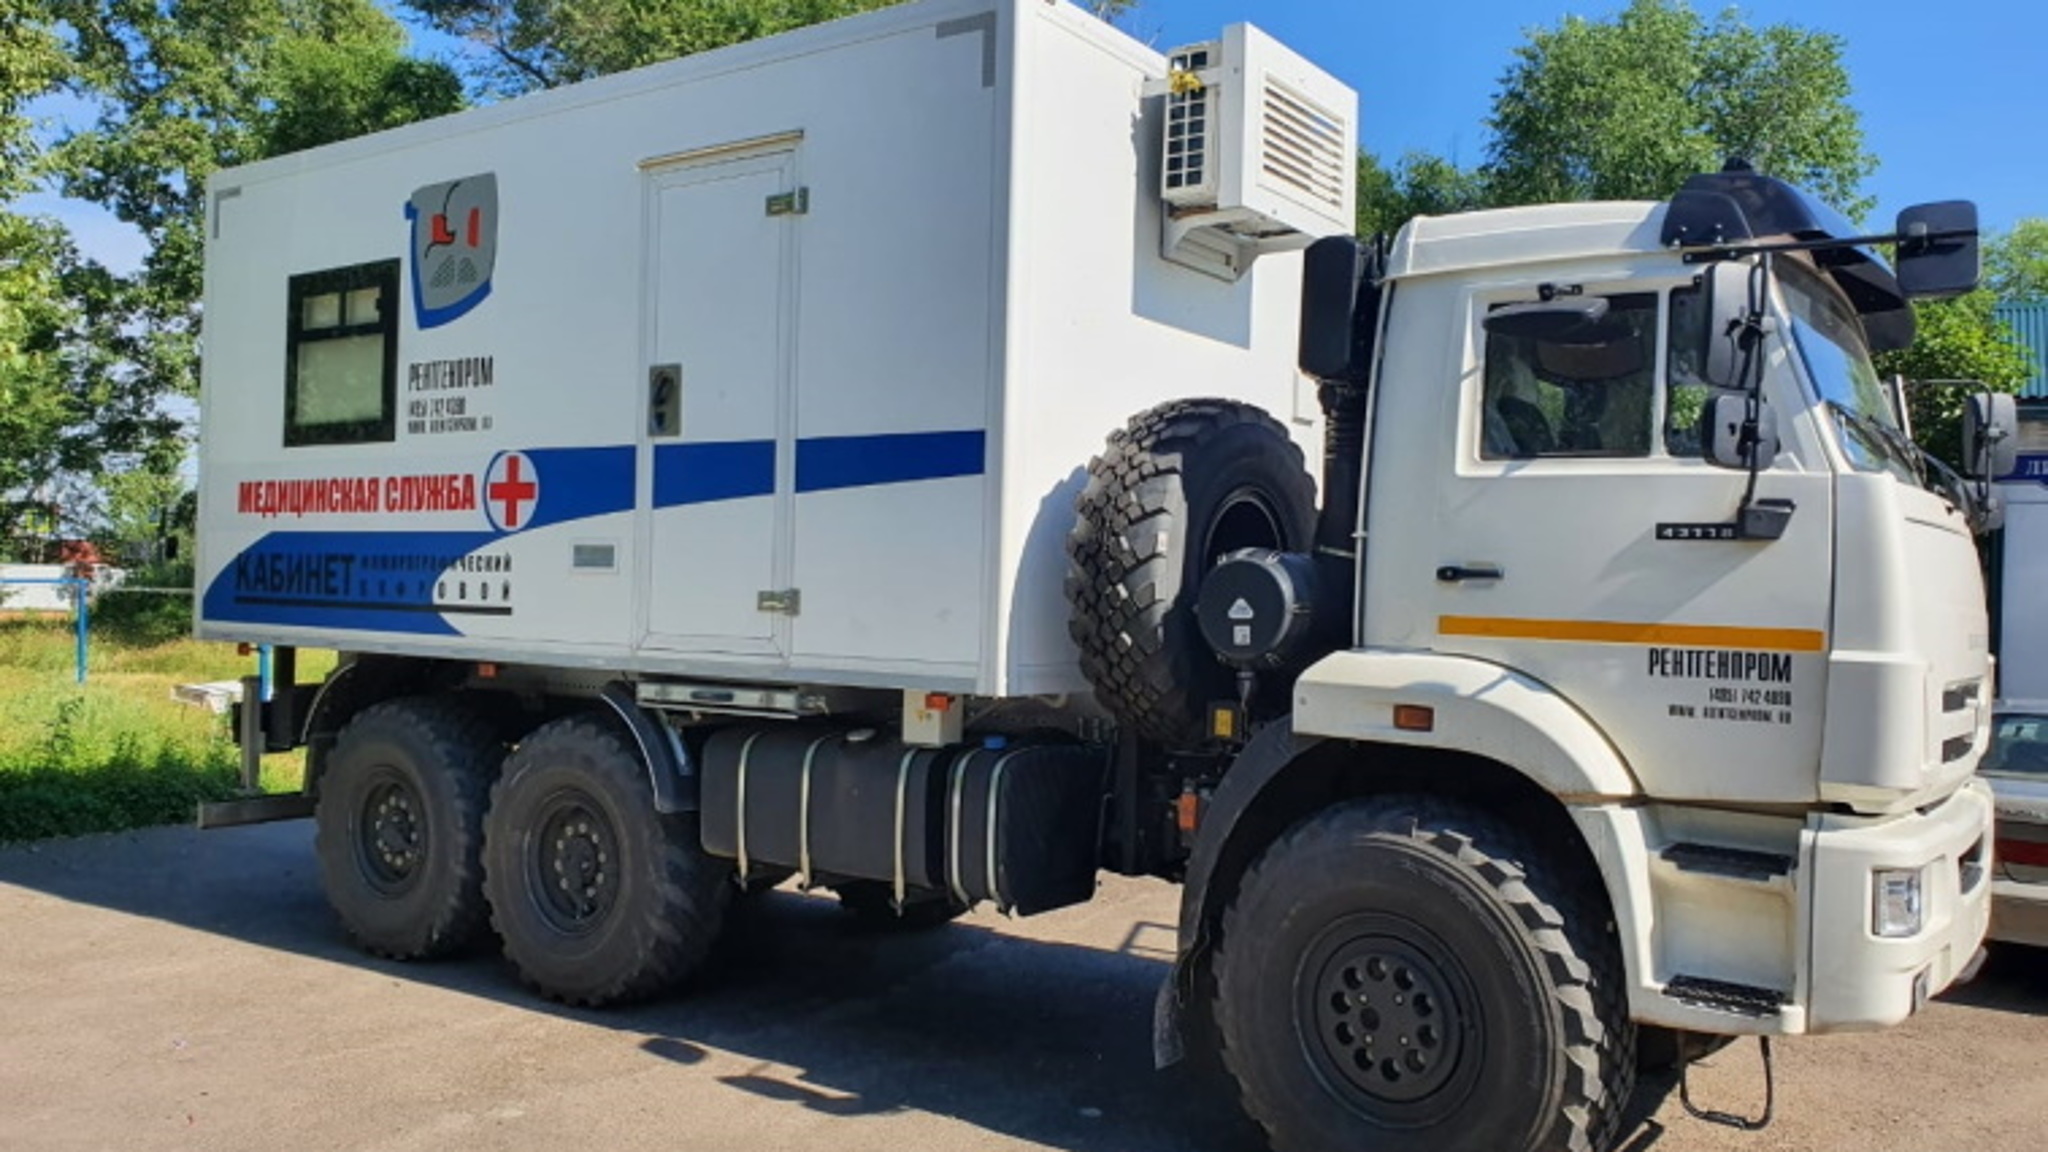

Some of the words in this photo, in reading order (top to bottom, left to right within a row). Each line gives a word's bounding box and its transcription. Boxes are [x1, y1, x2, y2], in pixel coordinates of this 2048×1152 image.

[237, 477, 380, 518] МЕДИЦИНСКАЯ
[385, 474, 477, 513] СЛУЖБА
[235, 551, 357, 596] КАБИНЕТ
[1648, 647, 1792, 683] РЕНТГЕНПРОМ
[1741, 687, 1762, 705] 742
